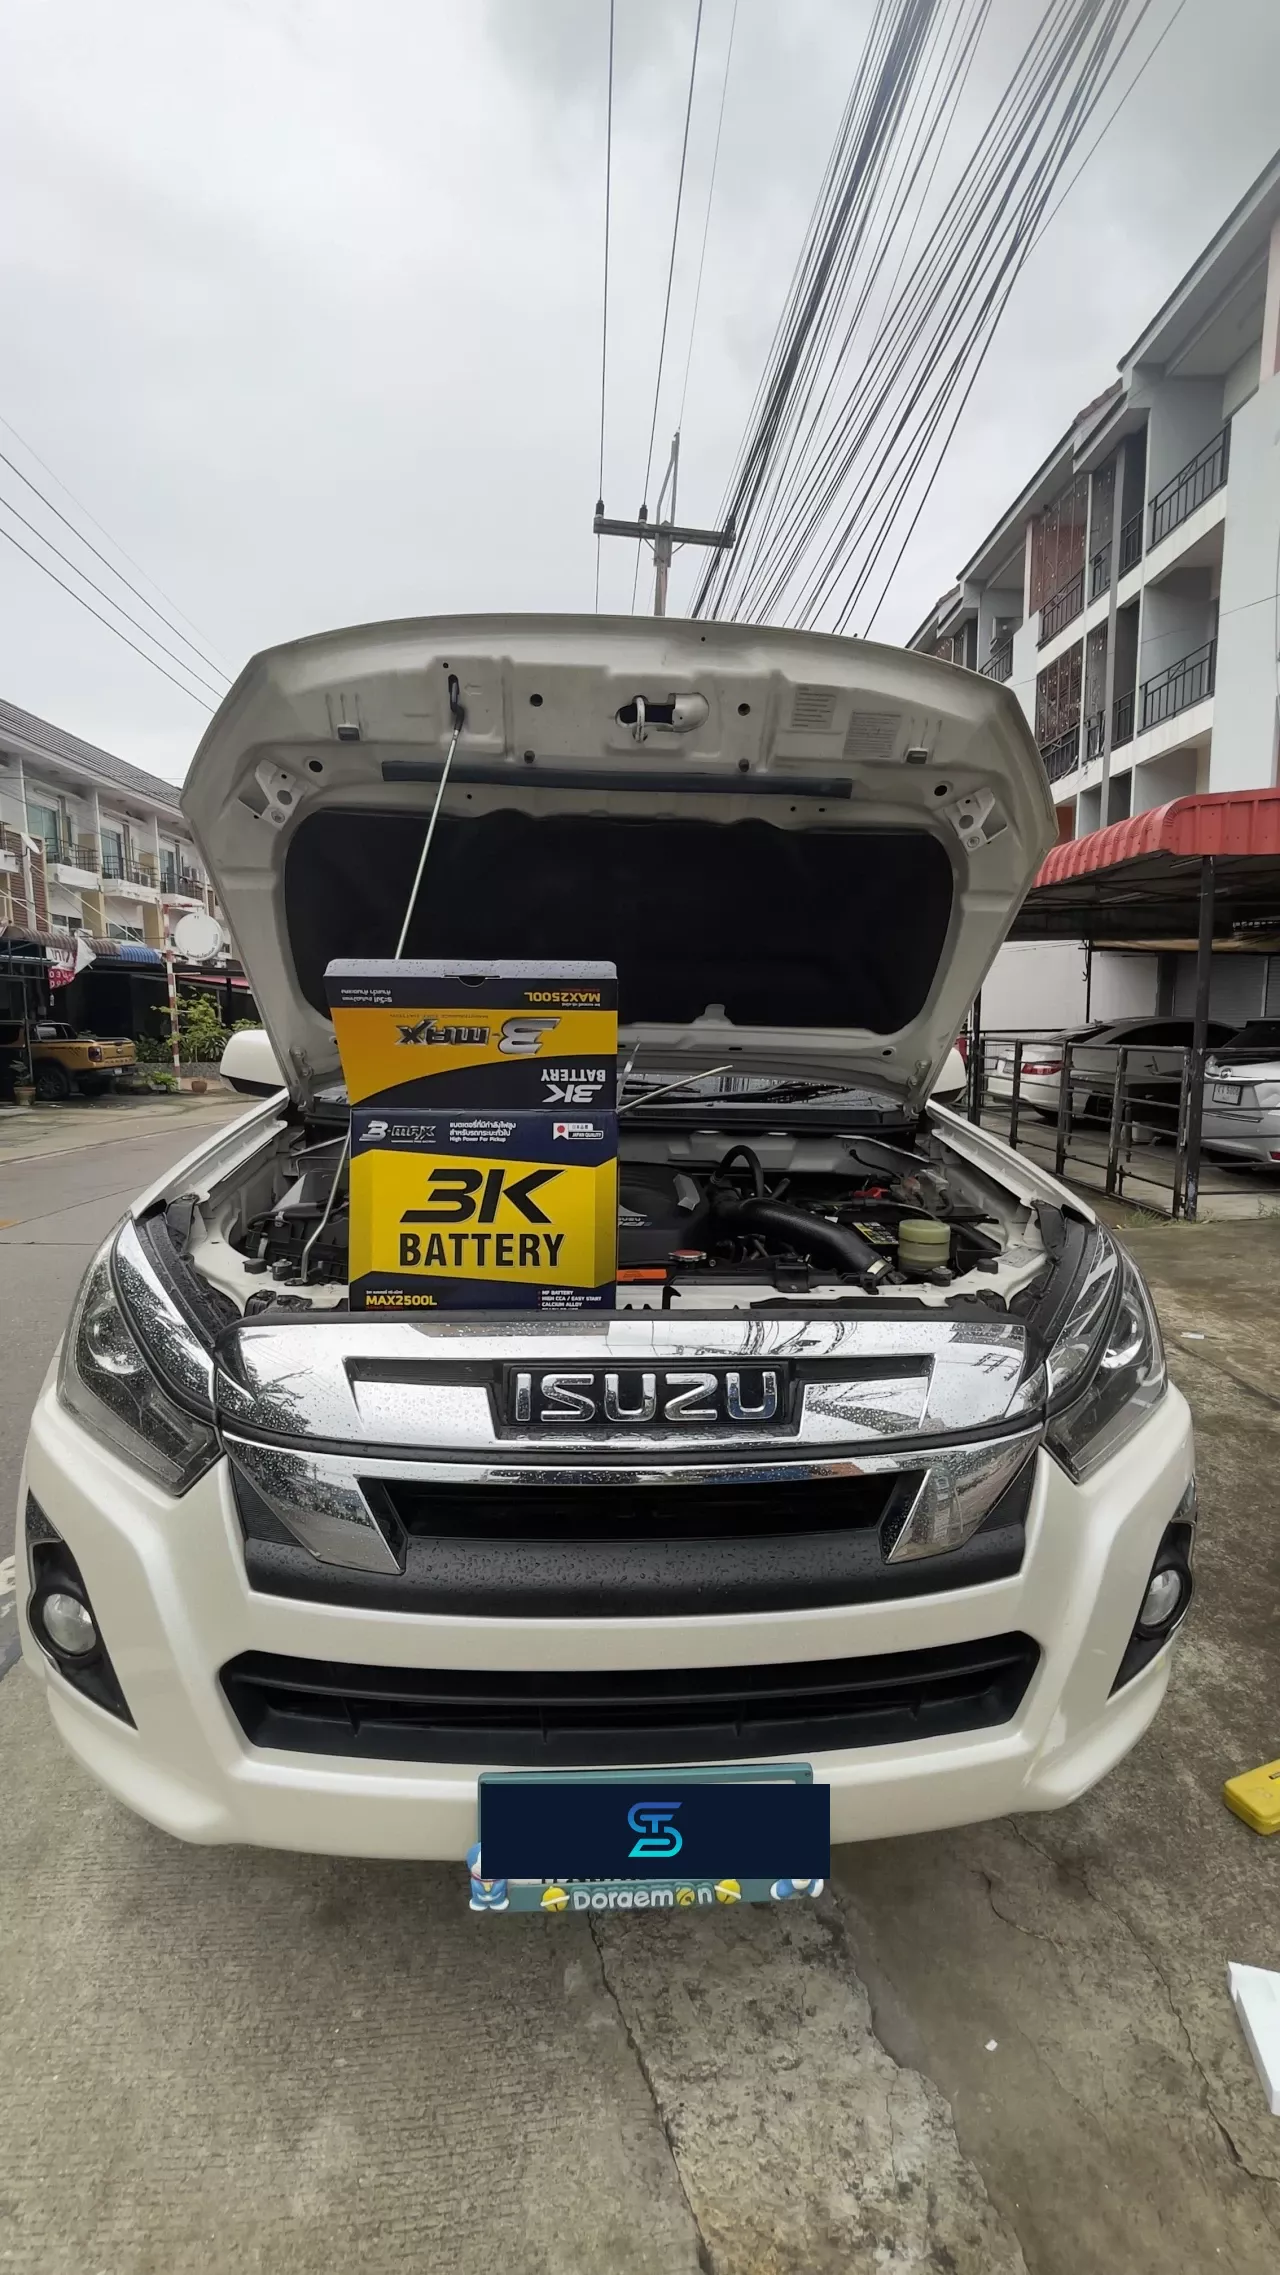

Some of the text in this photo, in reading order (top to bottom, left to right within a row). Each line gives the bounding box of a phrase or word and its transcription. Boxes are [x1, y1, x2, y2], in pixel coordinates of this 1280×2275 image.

[524, 992, 601, 1002] MAX2500L
[540, 1068, 606, 1082] BATTERY
[541, 1084, 603, 1103] 3K
[399, 1168, 567, 1224] 3K
[399, 1233, 565, 1267] BATTERY
[365, 1294, 438, 1306] MAX2500L
[515, 1371, 778, 1422] ISUZU
[572, 1887, 713, 1910] Doraemon
